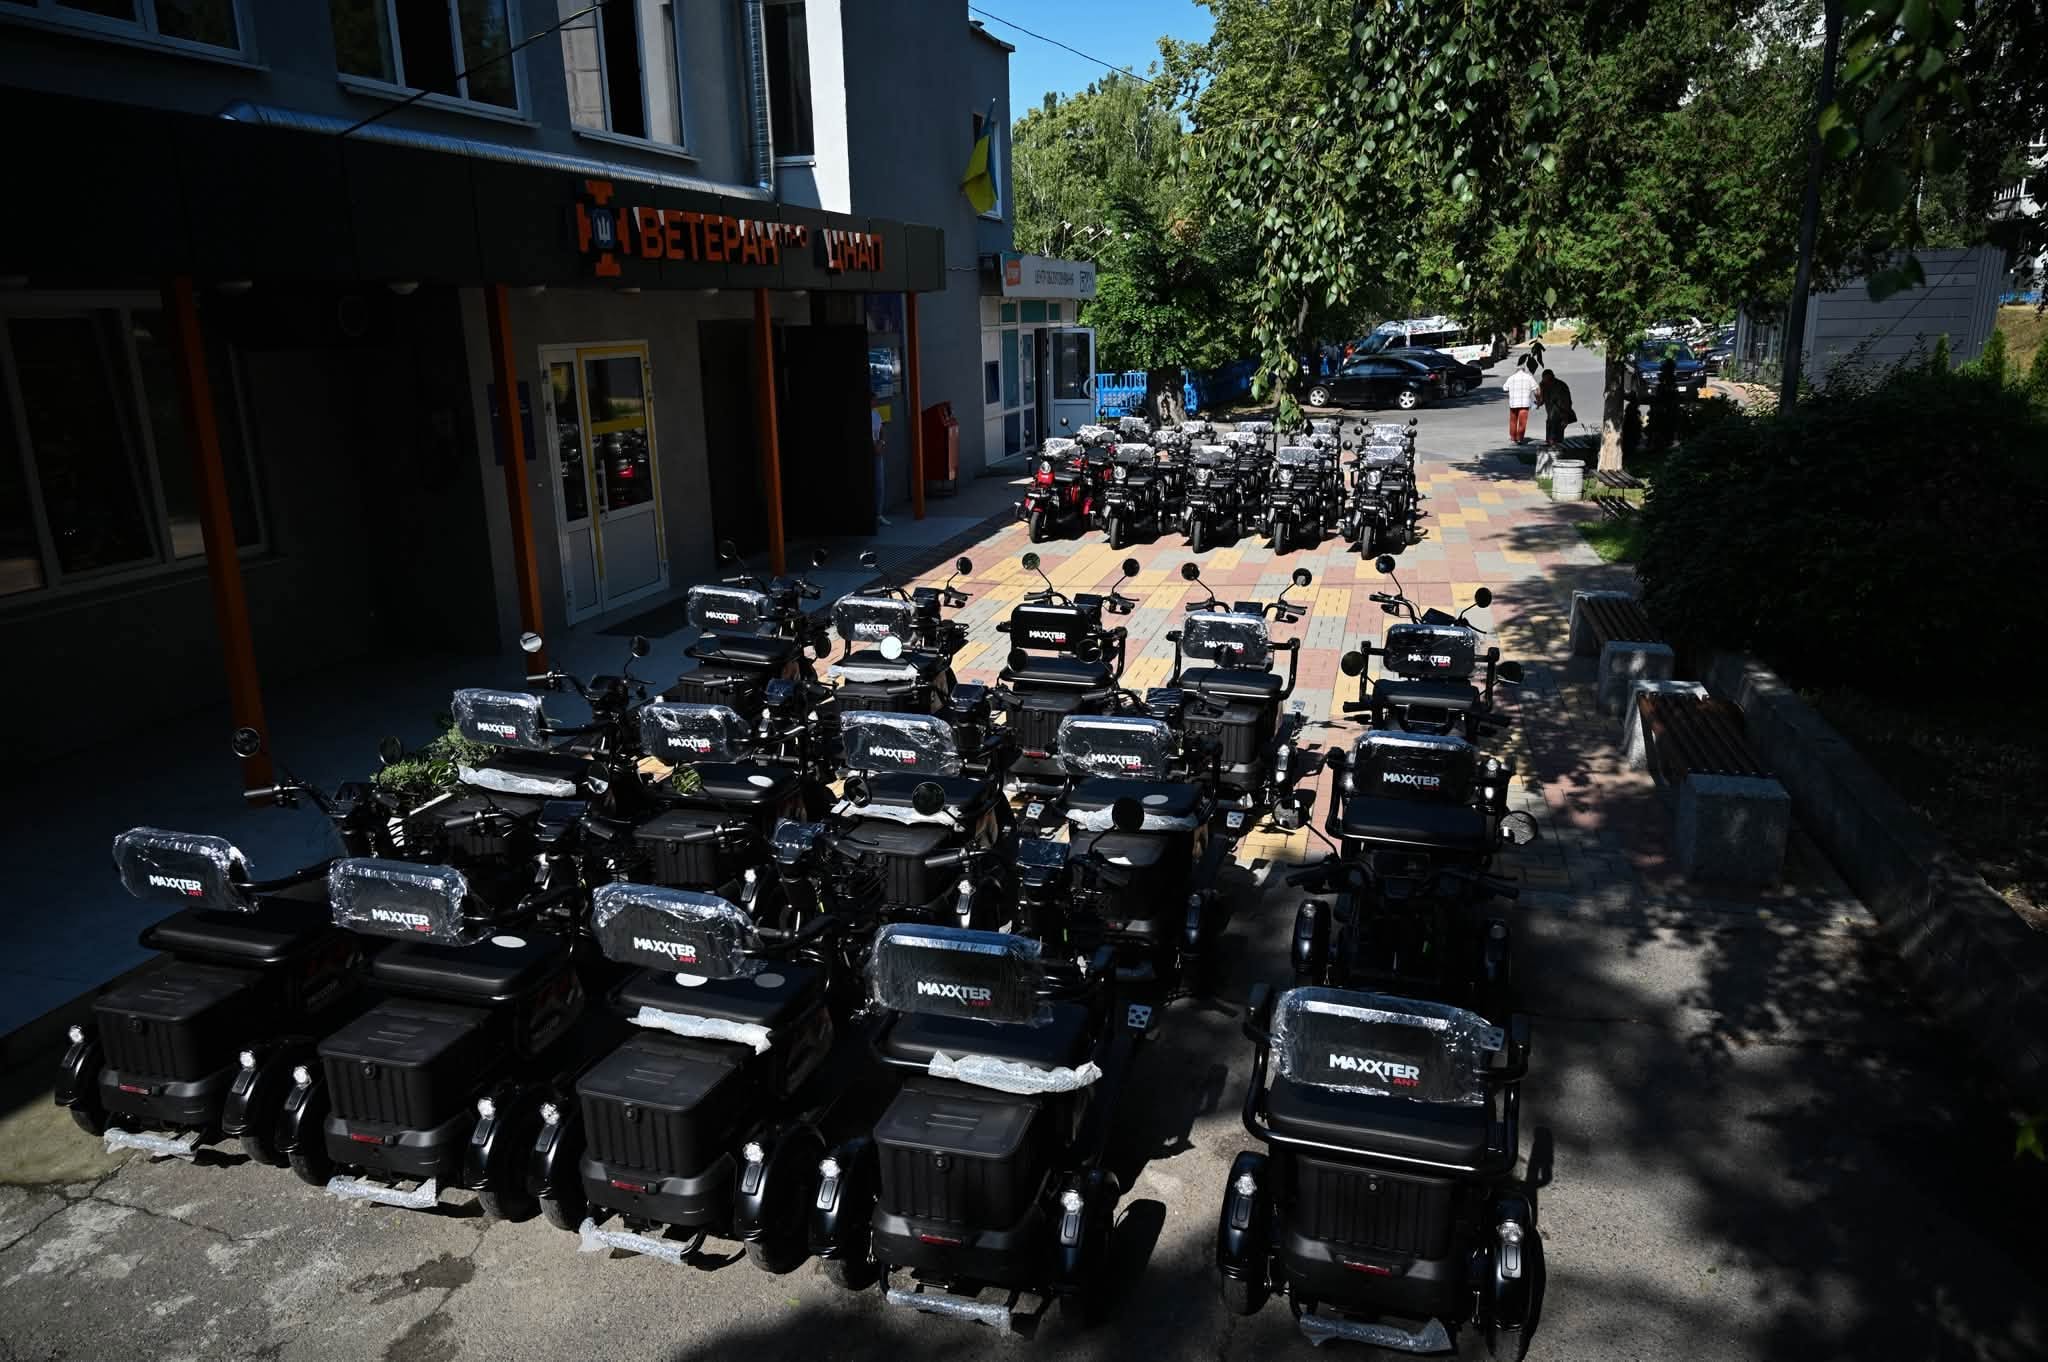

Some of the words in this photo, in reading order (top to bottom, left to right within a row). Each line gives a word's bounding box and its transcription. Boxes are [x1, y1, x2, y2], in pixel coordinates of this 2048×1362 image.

[634, 206, 779, 265] ВЕТЕРАН
[823, 228, 884, 274] ЦНАП
[1029, 630, 1066, 642] MAXXTER
[477, 722, 516, 737] MAXXTER
[668, 738, 711, 752] MAXXTER
[869, 746, 917, 763] MAXXTER
[1091, 753, 1141, 768] MAXXTER
[1383, 772, 1440, 790] MAXXTER
[149, 875, 202, 895] MAXXTER
[372, 909, 429, 930] MAXXTER
[633, 937, 696, 960] MAXXTER
[917, 981, 991, 1005] MAXXTER
[1330, 1053, 1419, 1082] MAXXTER
[1392, 1077, 1420, 1087] ANT
